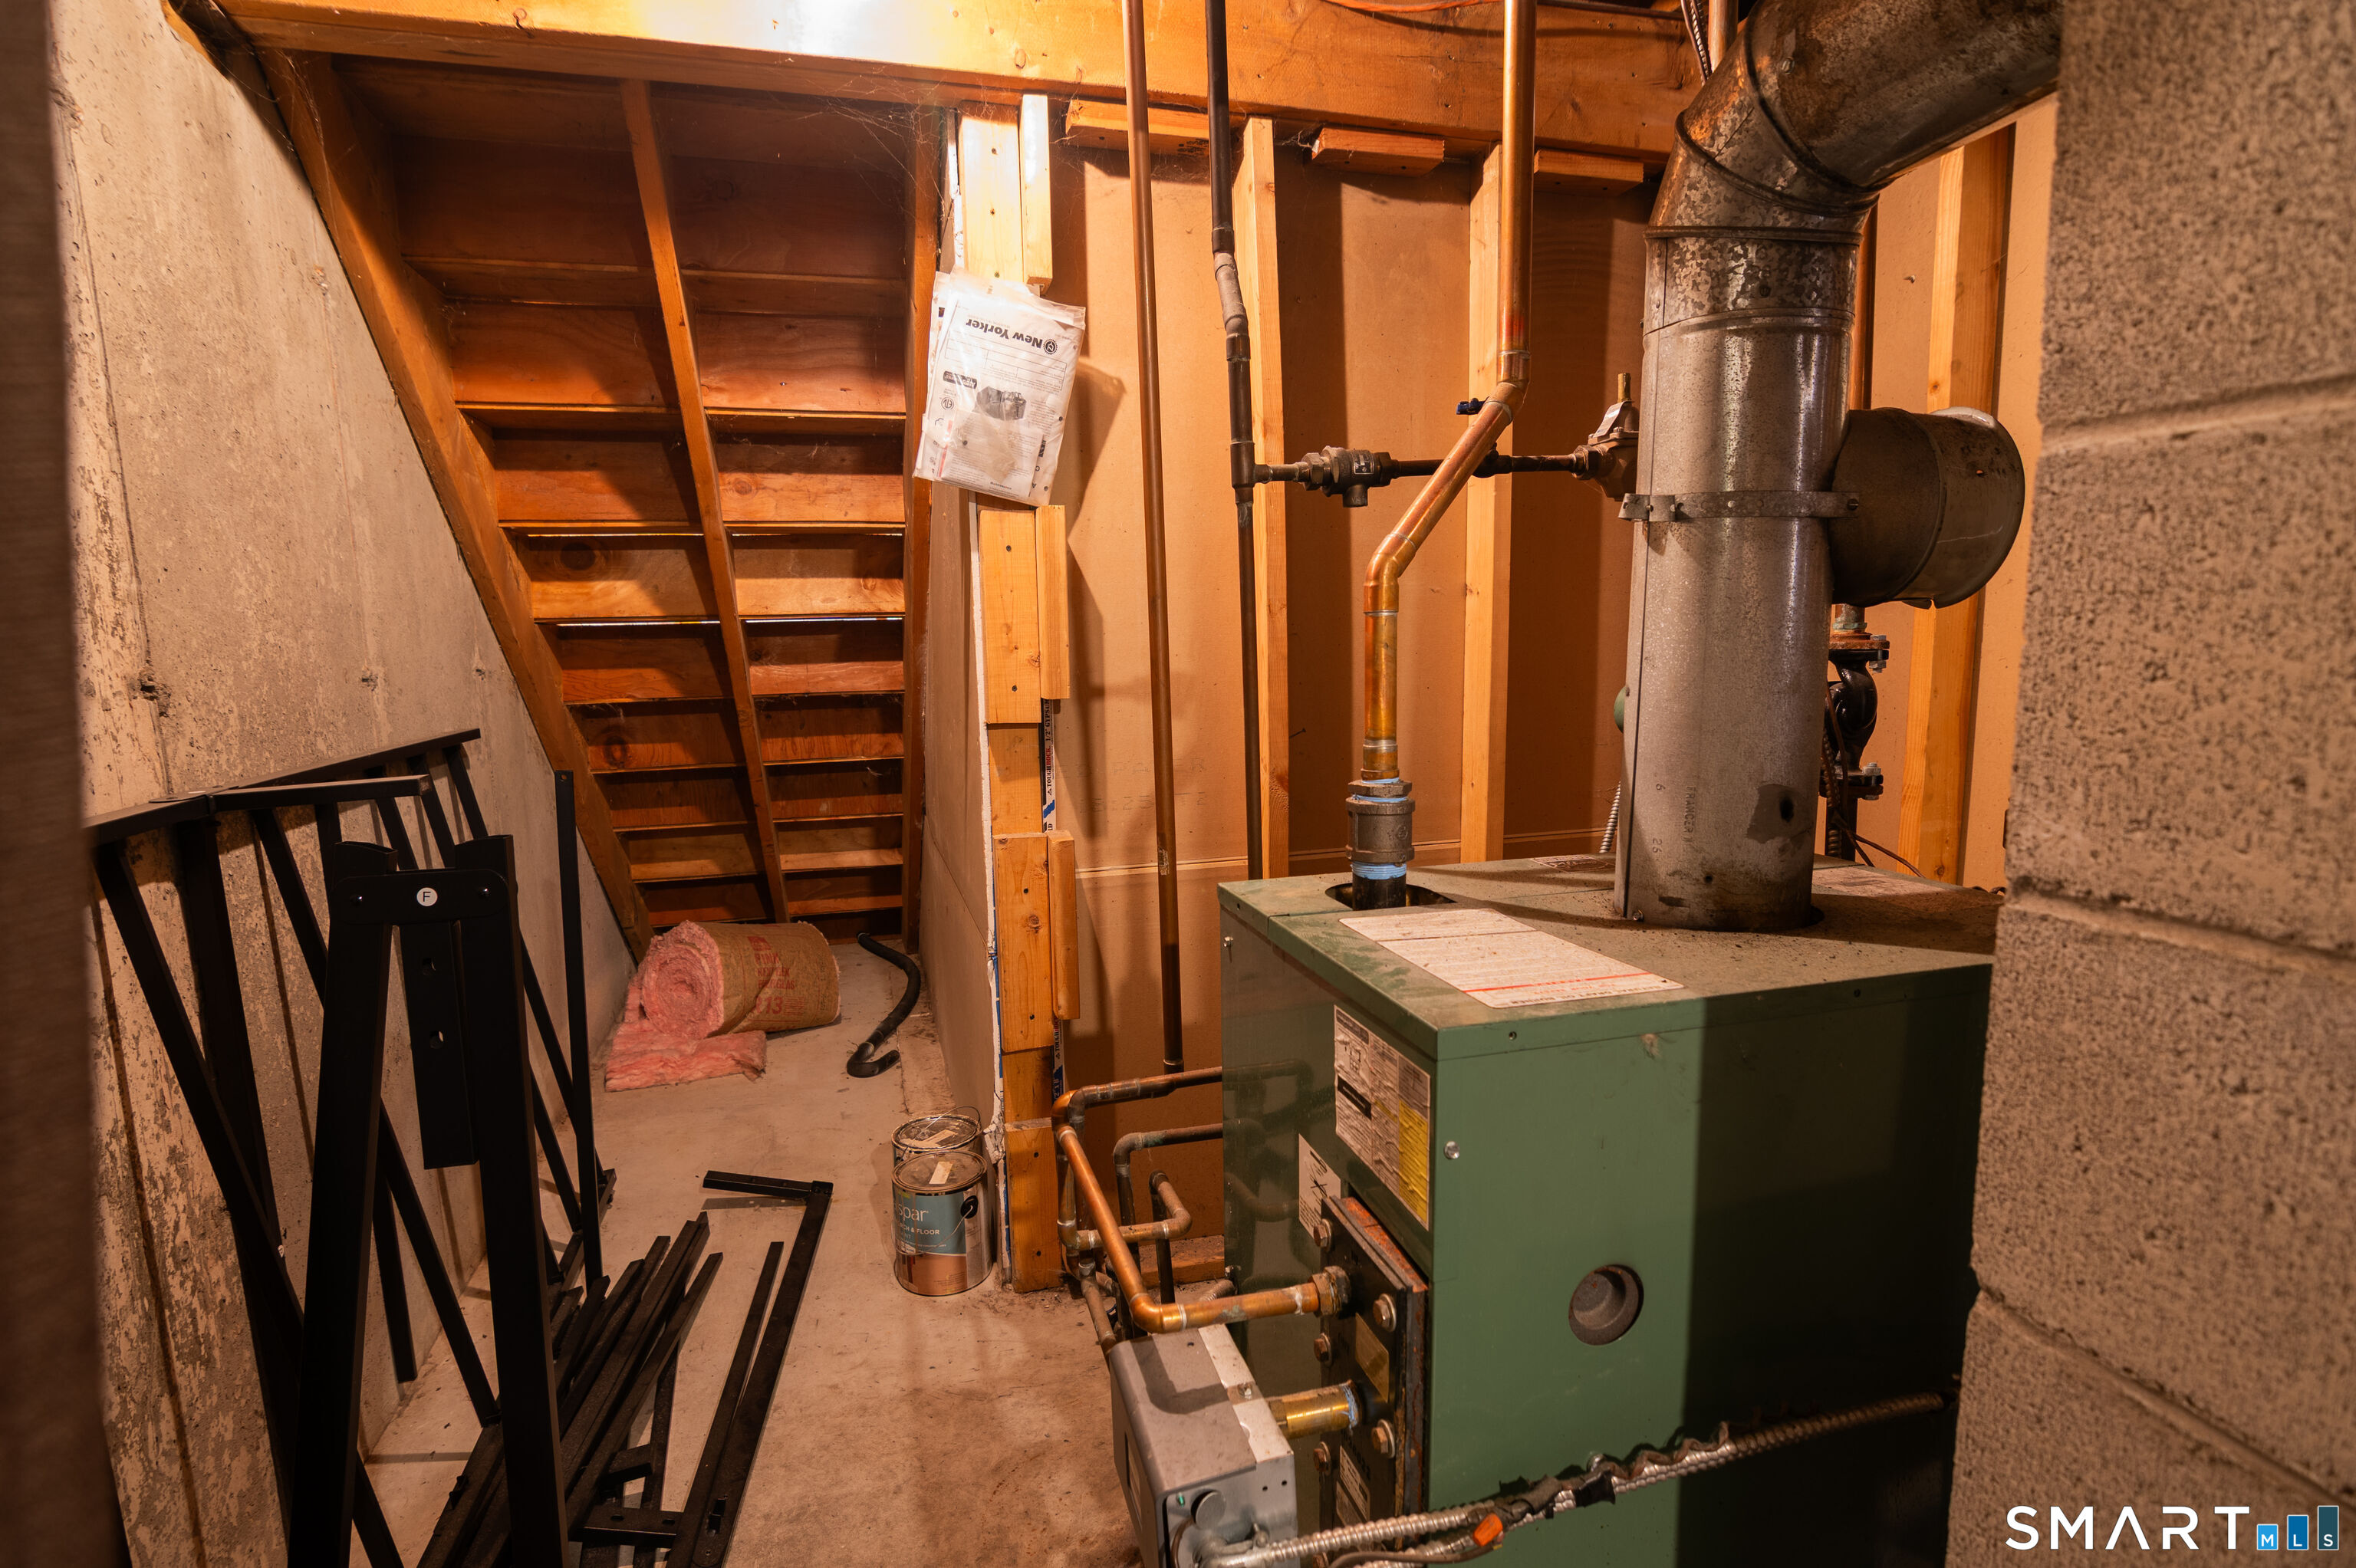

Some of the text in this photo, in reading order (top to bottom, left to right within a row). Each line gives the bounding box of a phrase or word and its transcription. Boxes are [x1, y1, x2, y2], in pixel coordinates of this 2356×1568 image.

[966, 318, 1009, 340] Yorker
[1012, 331, 1043, 349] New
[423, 891, 431, 902] F
